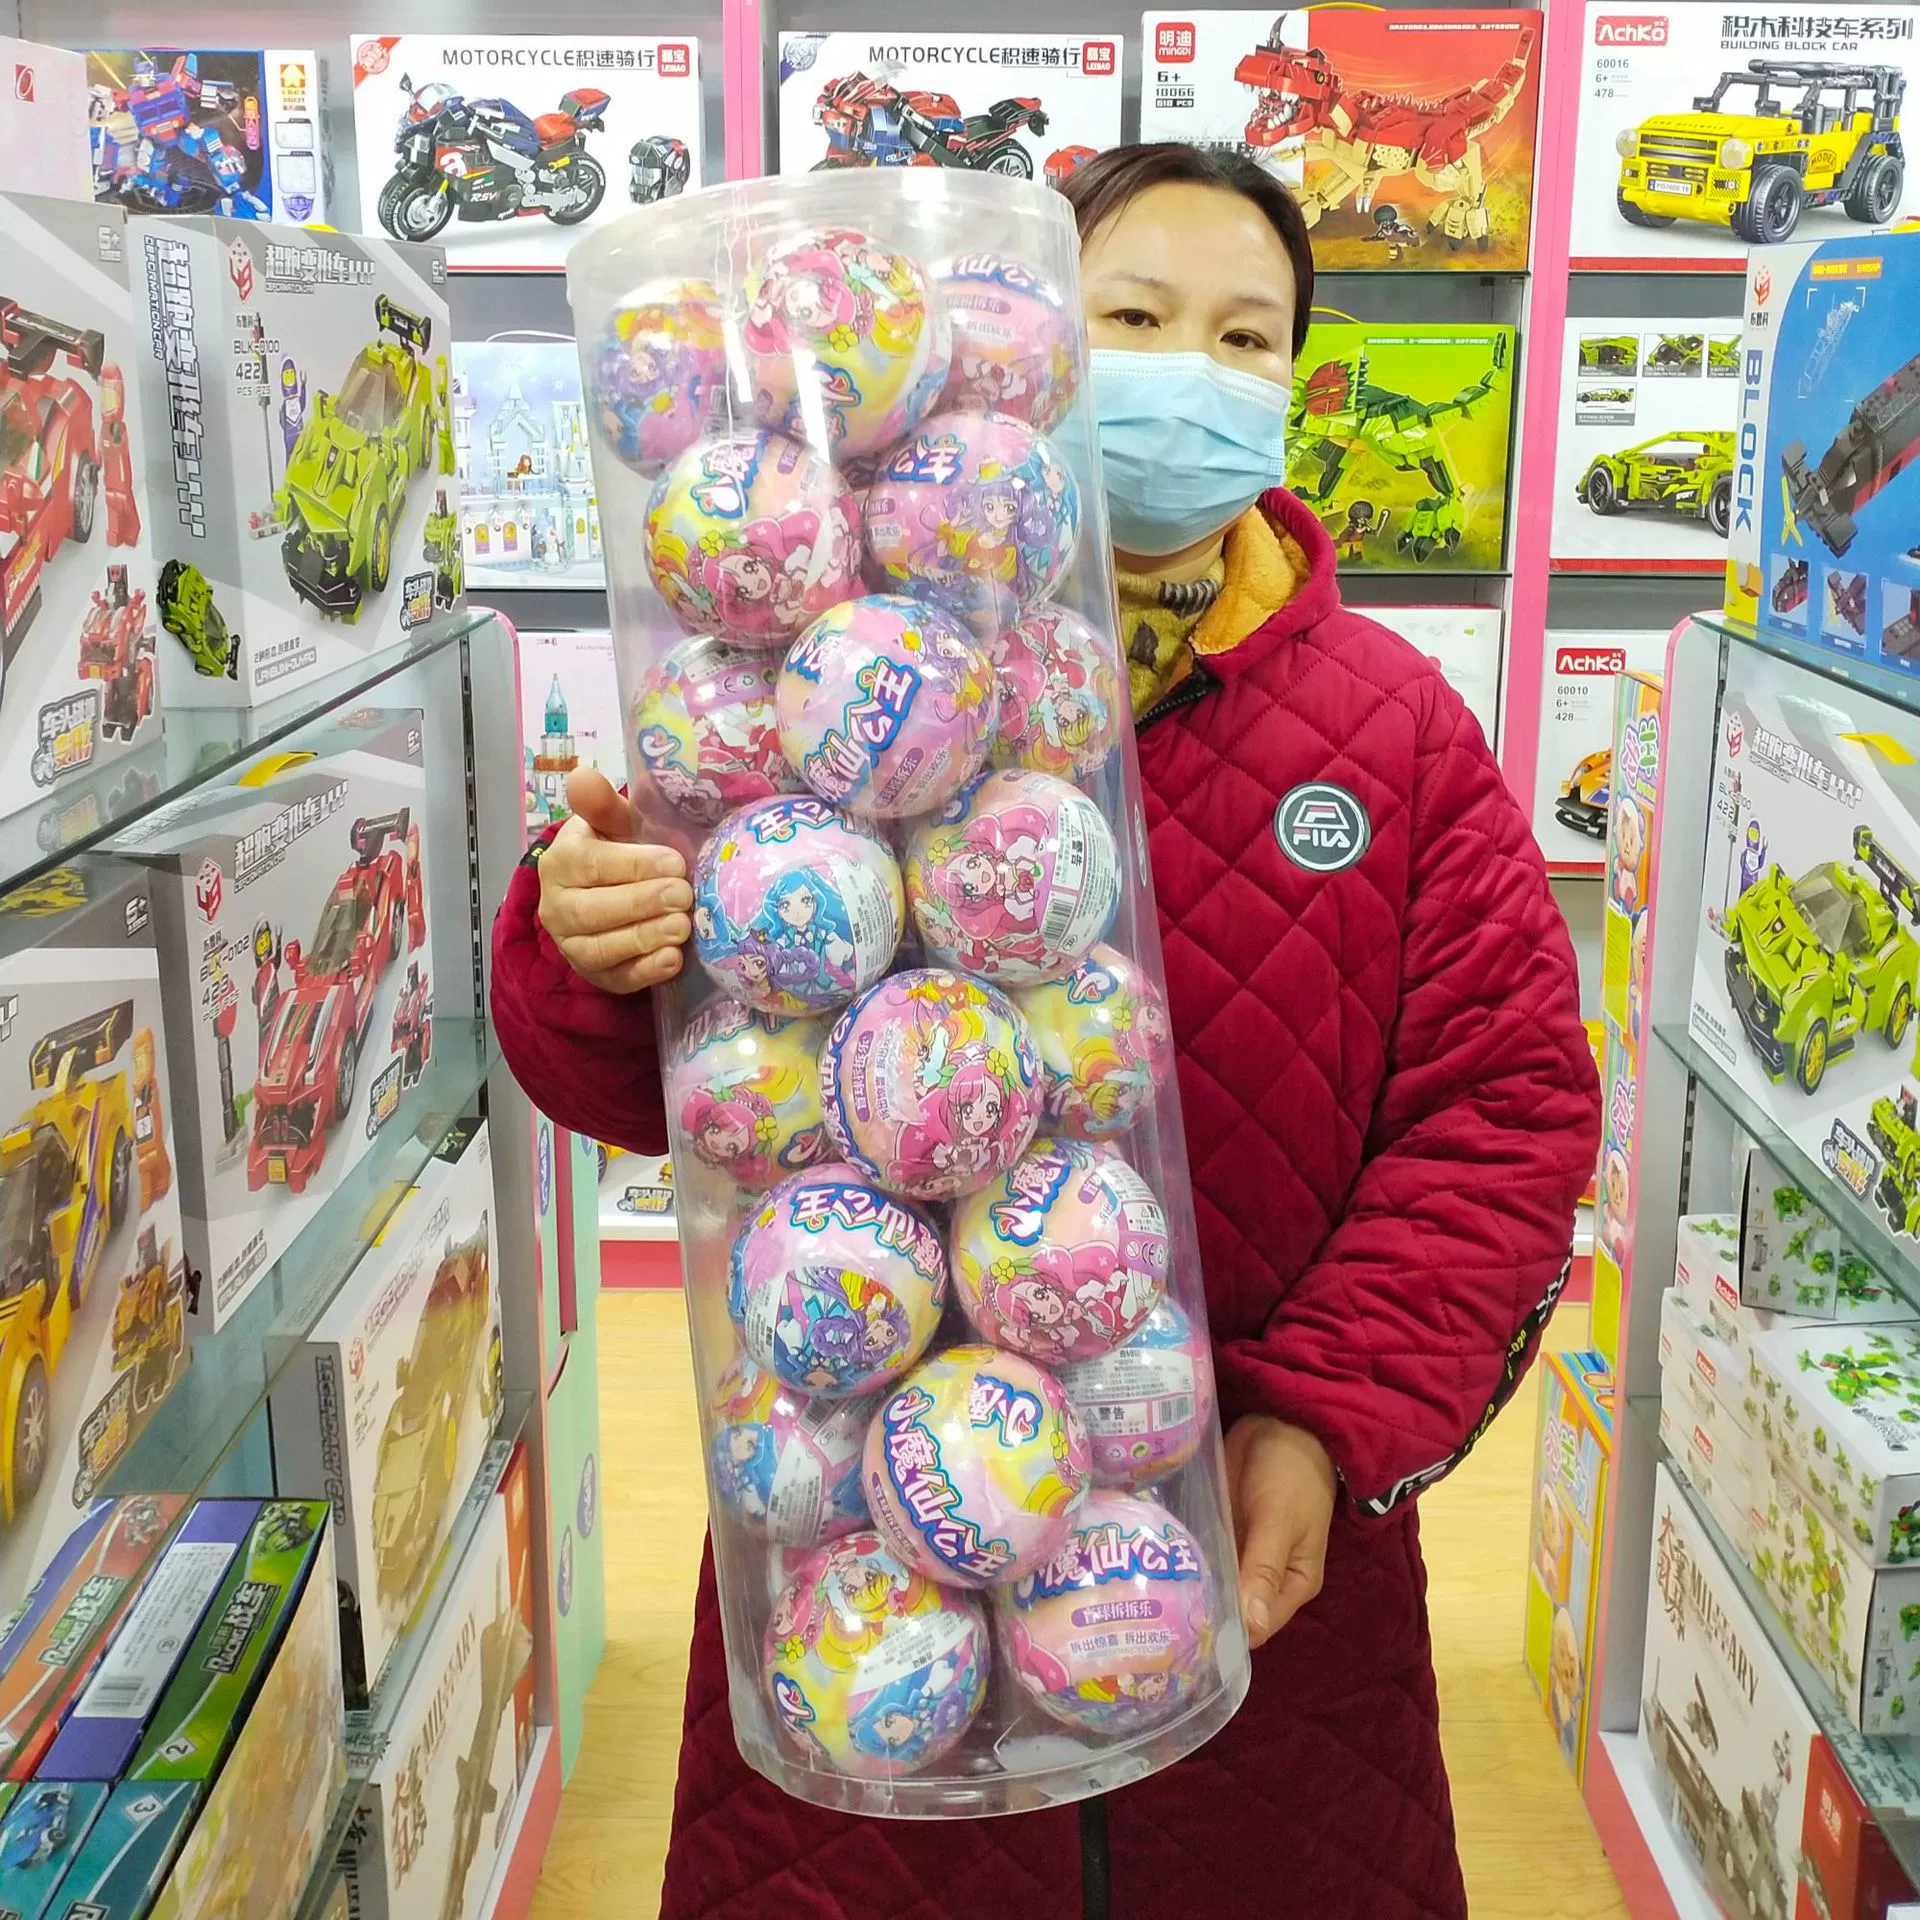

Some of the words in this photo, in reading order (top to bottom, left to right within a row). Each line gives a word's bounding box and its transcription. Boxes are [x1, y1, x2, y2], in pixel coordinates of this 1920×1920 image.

[1721, 15, 1913, 40] 积木科技车系列
[1158, 29, 1192, 46] 明迪
[1721, 41, 1779, 50] BUILDING
[1785, 41, 1827, 51] BLOCK
[1833, 42, 1857, 51] CAR
[1596, 58, 1629, 69] 60016
[1157, 71, 1182, 84] 6+
[1594, 88, 1614, 99] 478
[236, 363, 262, 380] 422
[1736, 349, 1763, 534] BLOCK
[1557, 686, 1589, 696] 60010
[1555, 712, 1574, 722] 428
[1293, 828, 1351, 848] FILA
[1098, 1406, 1125, 1421] 警告
